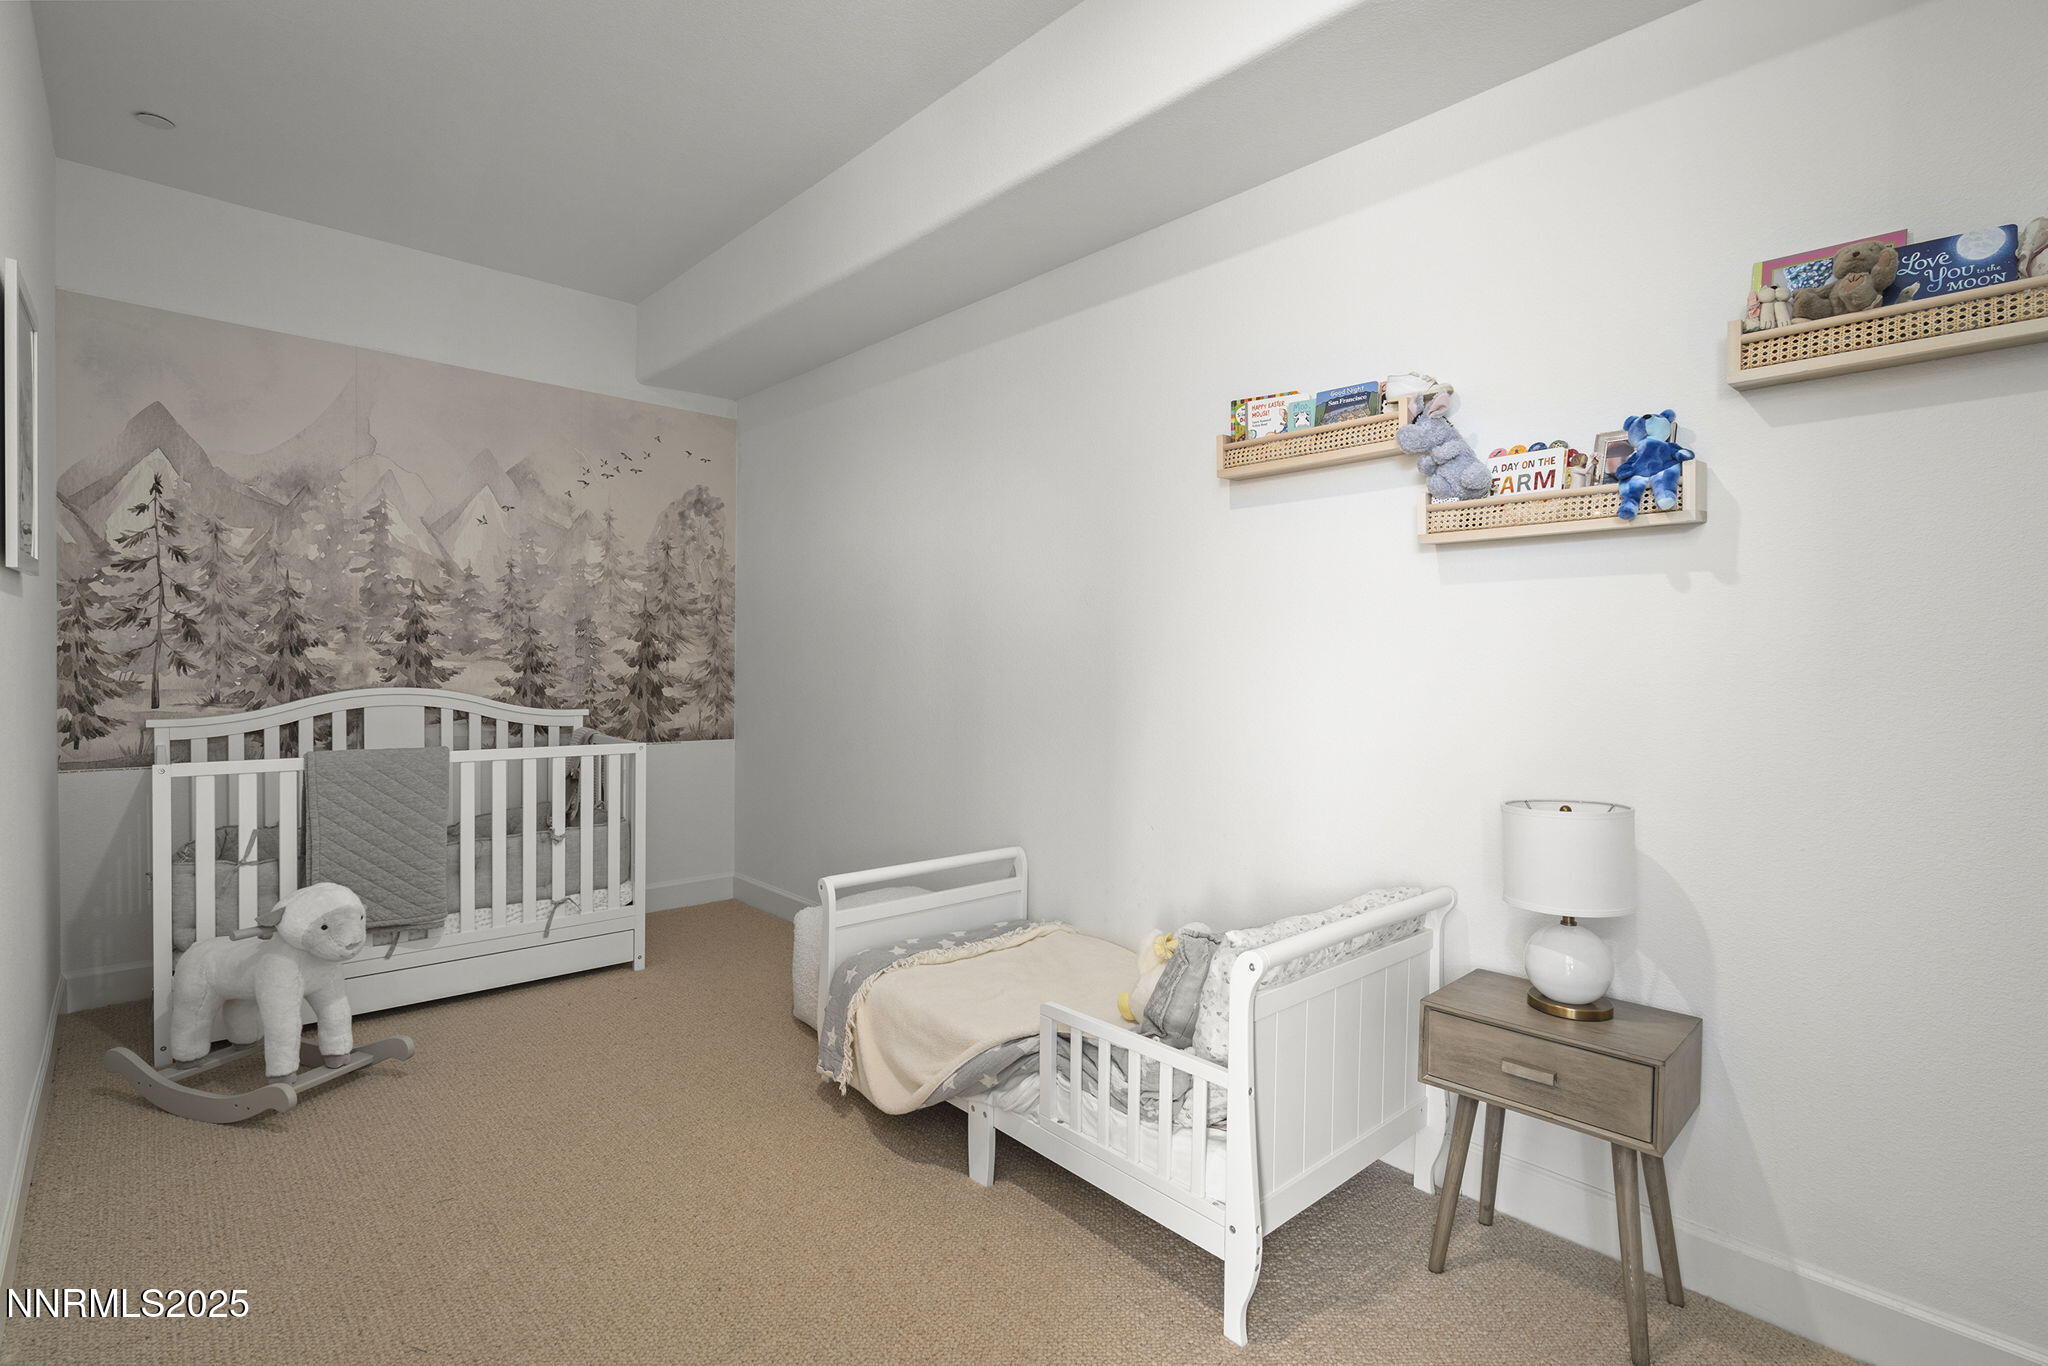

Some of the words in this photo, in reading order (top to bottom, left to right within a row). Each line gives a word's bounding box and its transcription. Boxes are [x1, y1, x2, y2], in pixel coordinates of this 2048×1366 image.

[1897, 252, 1952, 275] Love
[1924, 264, 1975, 293] YOU
[1987, 264, 2001, 272] the
[1947, 272, 2007, 291] MOON
[1339, 393, 1367, 404] Francisco
[1501, 462, 1519, 472] DAY
[1522, 460, 1535, 469] ON
[1538, 456, 1556, 466] THE
[1490, 469, 1556, 496] FARM
